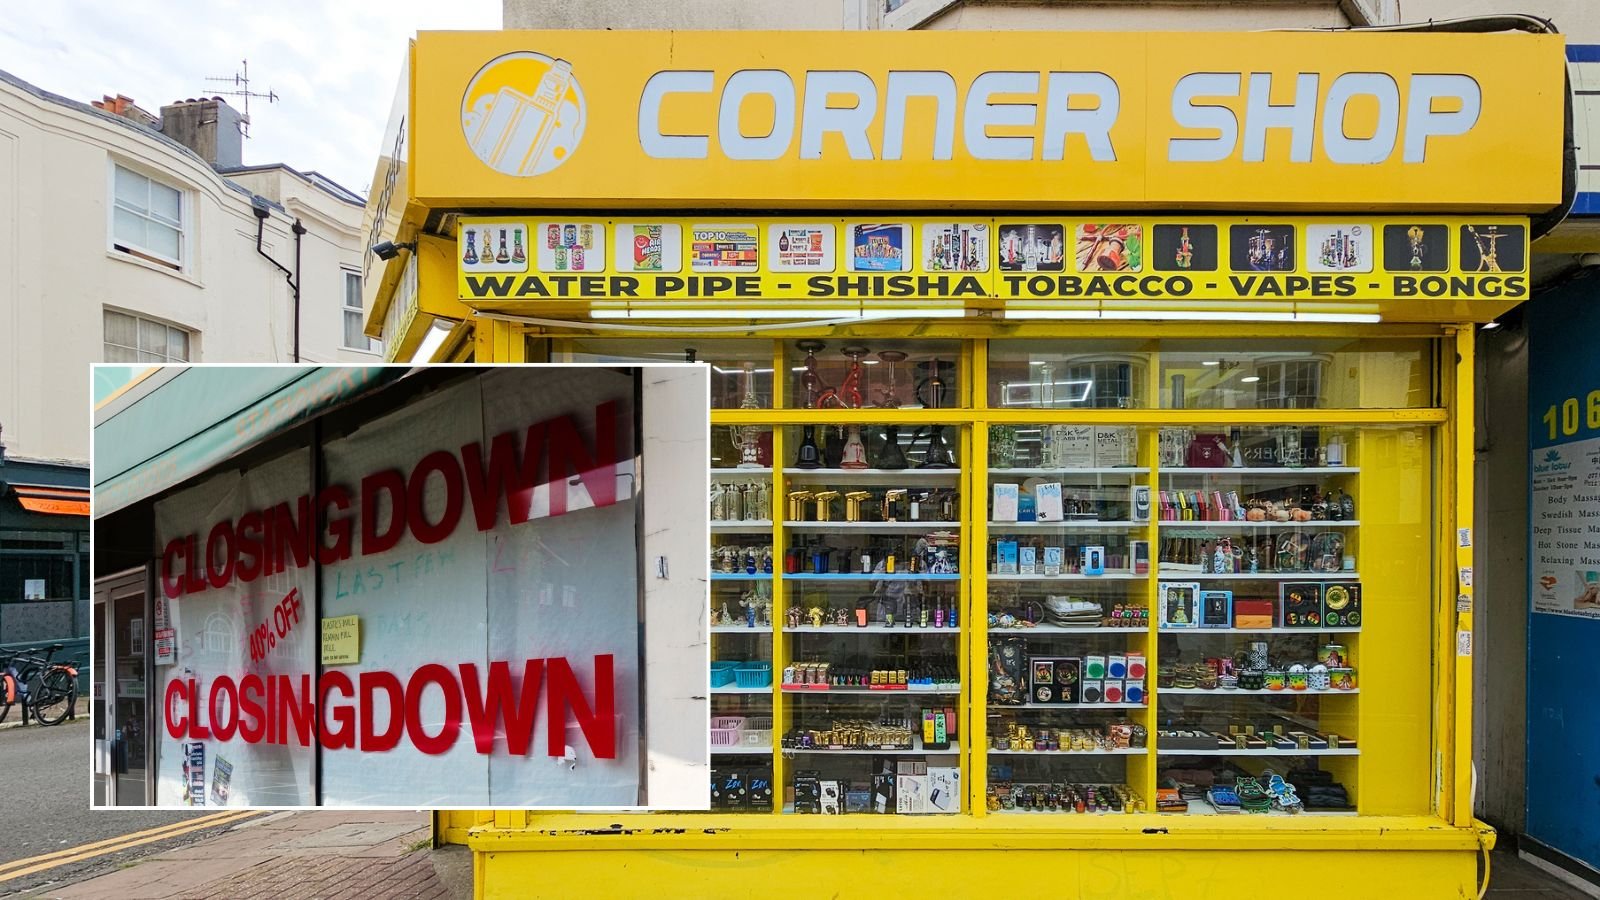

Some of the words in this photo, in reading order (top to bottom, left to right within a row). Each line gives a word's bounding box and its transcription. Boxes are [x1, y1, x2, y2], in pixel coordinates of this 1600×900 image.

[638, 69, 1120, 161] CORNER
[1168, 71, 1482, 164] SHOP
[694, 232, 714, 241] TOP
[716, 232, 726, 241] 10
[465, 275, 638, 297] WATER
[655, 275, 763, 297] PIPE
[807, 275, 987, 297] SHISHA
[1003, 275, 1193, 297] TOBACCO
[1229, 275, 1356, 297] VAPES
[1393, 275, 1527, 297] BONGS
[1543, 390, 1600, 440] 106
[361, 400, 618, 557] DOWN
[1548, 496, 1567, 504] Body
[1541, 510, 1573, 519] Swedish
[1534, 526, 1551, 535] Deep
[1538, 541, 1551, 549] Hot
[1556, 541, 1578, 549] Stone
[1541, 556, 1574, 566] Relaxing
[336, 560, 404, 600] LAST
[250, 618, 275, 664] 40%
[274, 587, 300, 639] OFF
[165, 671, 355, 750] CLOSING
[360, 654, 616, 760] DOWN
